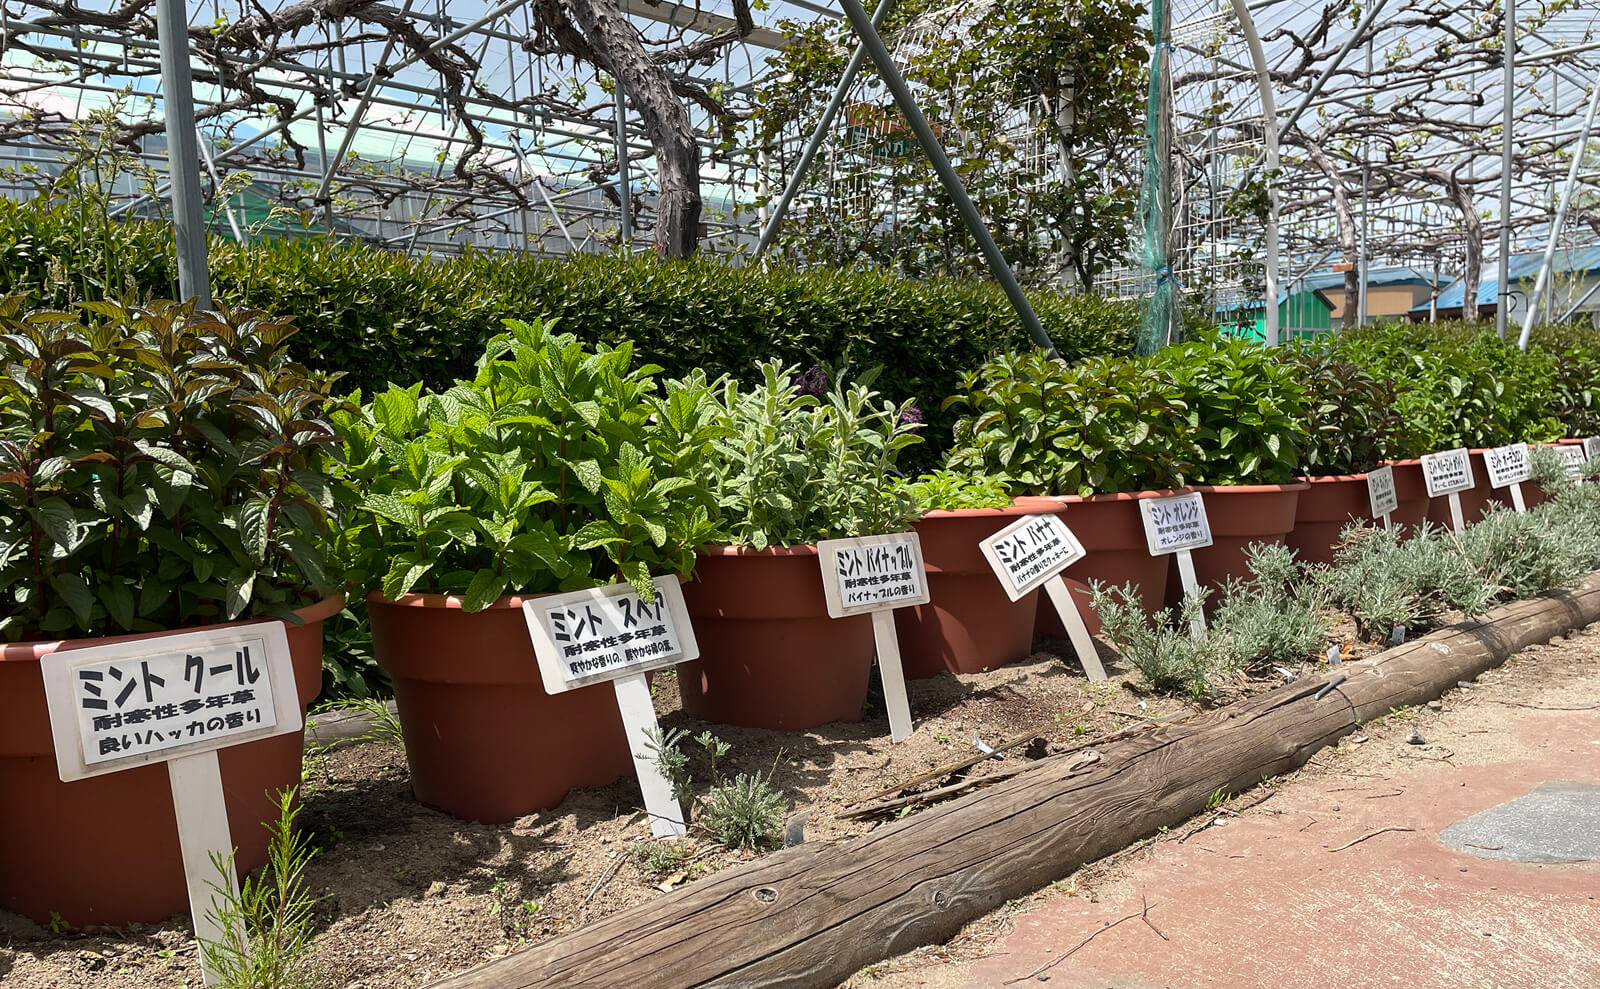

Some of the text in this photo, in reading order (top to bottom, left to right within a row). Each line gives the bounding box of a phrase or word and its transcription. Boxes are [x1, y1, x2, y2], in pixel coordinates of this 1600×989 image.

[1151, 500, 1199, 526] ミント オレンジ
[994, 517, 1056, 563] ミント バナナ
[1160, 530, 1203, 545] オレンジの香り
[837, 544, 913, 577] ミント パイナップル
[1009, 537, 1062, 574] 耐寒性多年草
[844, 571, 912, 589] 耐寒性多年草
[848, 583, 915, 603] パイナップルの香り
[550, 605, 602, 642] ミント
[563, 624, 667, 658] 耐寒性多年草
[79, 646, 261, 711] ミント クール
[92, 689, 256, 732] 耐寒性多年草
[98, 708, 261, 756] 良いハッカの香り
